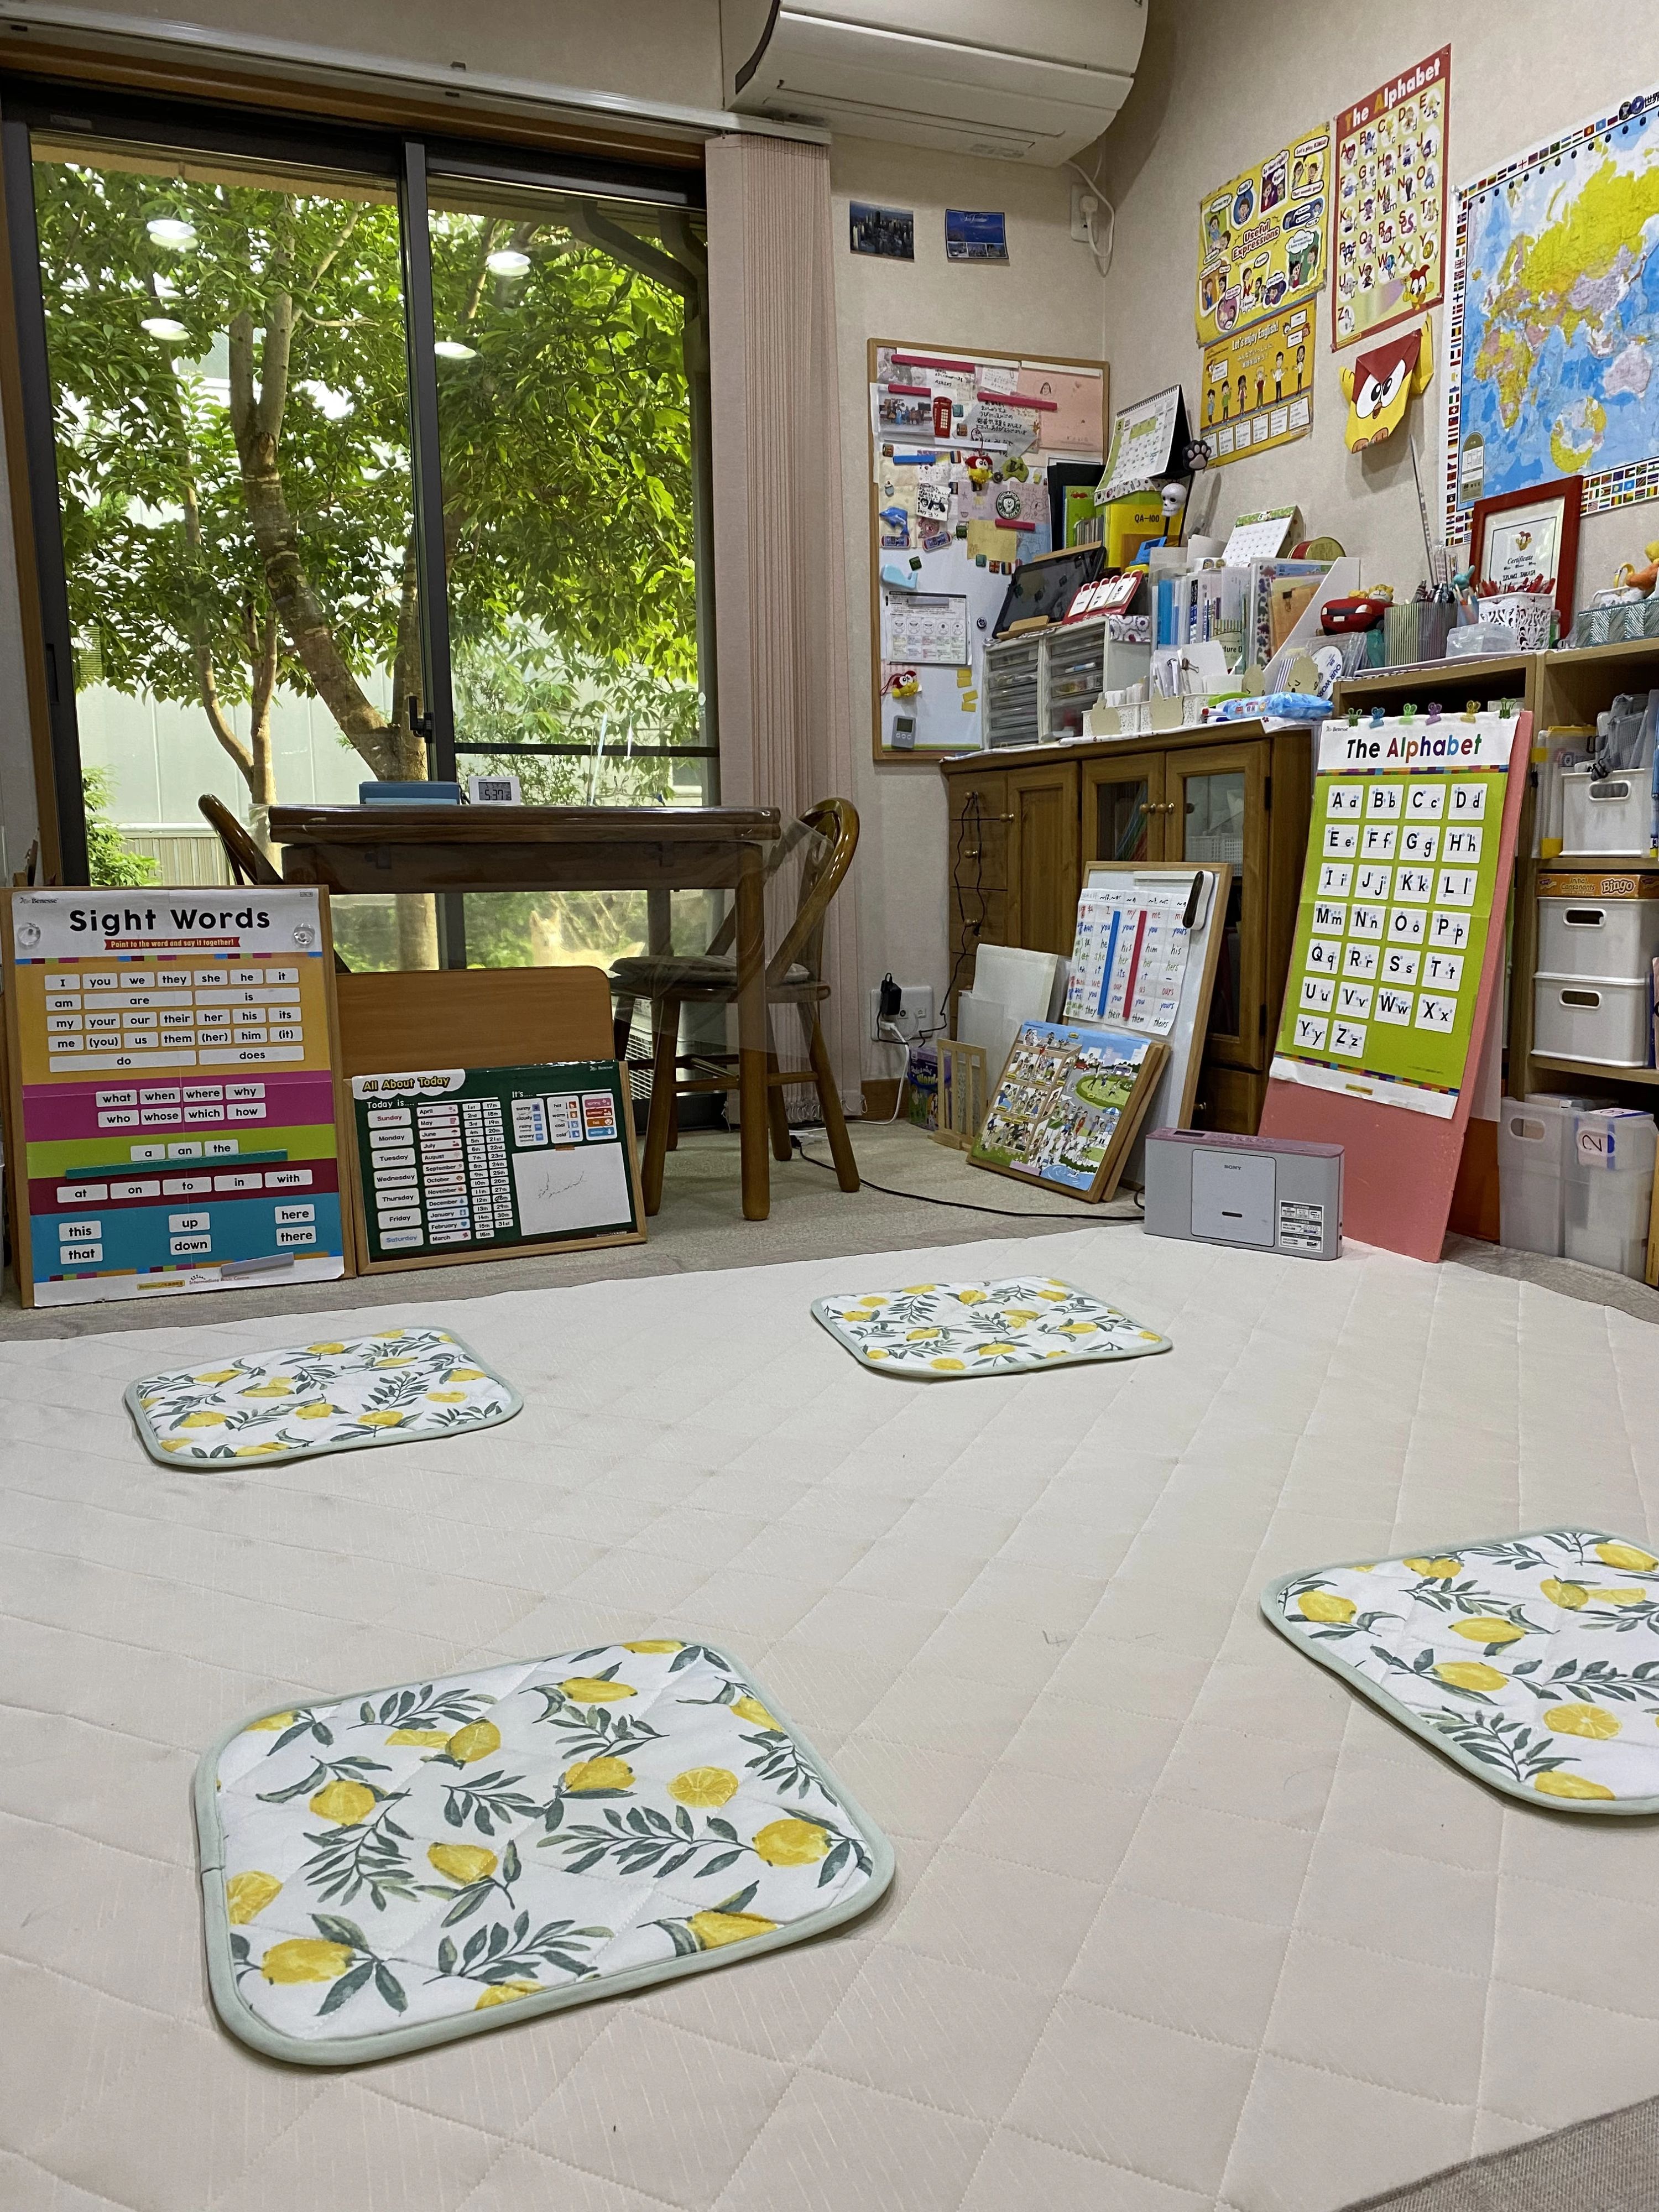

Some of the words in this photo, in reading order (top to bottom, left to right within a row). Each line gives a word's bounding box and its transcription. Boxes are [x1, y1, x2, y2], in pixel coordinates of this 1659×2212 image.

[1345, 106, 1369, 132] The
[1374, 58, 1440, 110] Alphabet
[1244, 221, 1270, 241] Useful
[1233, 229, 1279, 259] Expressions
[1232, 339, 1244, 351] Let's
[1244, 333, 1258, 346] enjoy
[1259, 321, 1279, 340] English!
[1117, 421, 1121, 430] 5
[1135, 514, 1159, 522] QA-100
[1507, 555, 1533, 564] Certificate
[1503, 573, 1517, 581] IZUMI
[1329, 664, 1341, 680] OUR
[1316, 680, 1332, 698] WOR
[1347, 739, 1380, 759] The
[1386, 734, 1481, 763] Alphabet
[485, 789, 503, 801] 5:37
[1602, 879, 1634, 894] Bingo
[1128, 910, 1135, 919] my
[70, 909, 156, 936] Sight
[170, 908, 269, 929] Words
[1100, 924, 1110, 933] you
[1122, 925, 1135, 933] your
[1148, 927, 1157, 936] you
[1172, 928, 1187, 937] yours
[111, 940, 127, 948] Point
[204, 938, 233, 946] together!
[1100, 940, 1107, 948] he
[1121, 943, 1131, 952] his
[1145, 943, 1157, 952] him
[1171, 944, 1181, 955] his
[1094, 952, 1105, 961] she
[1118, 955, 1128, 964] her
[1143, 959, 1152, 967] her
[1166, 961, 1178, 971] hers
[90, 979, 110, 988] you
[163, 976, 186, 985] they
[1088, 990, 1097, 1000] you
[1160, 1003, 1174, 1011] yours
[90, 1019, 116, 1028] your
[164, 1014, 190, 1023] their
[243, 1011, 257, 1020] his
[1085, 1004, 1097, 1017] they
[1108, 1009, 1120, 1019] their
[1132, 1014, 1144, 1022] them
[1154, 1019, 1168, 1028] theirs
[90, 1037, 118, 1048] (you)
[202, 1032, 227, 1042] (her)
[242, 1031, 260, 1040] him
[279, 1030, 293, 1039] (it)
[362, 1081, 378, 1092] All
[382, 1078, 414, 1090] About
[418, 1076, 450, 1088] Today
[102, 1093, 131, 1103] what
[145, 1092, 175, 1100] when
[234, 1088, 256, 1097] why
[367, 1100, 394, 1109] Today
[107, 1115, 130, 1123] who
[188, 1109, 220, 1118] which
[377, 1114, 403, 1122] Sunday
[379, 1134, 405, 1143] Monday
[1583, 1135, 1602, 1151] 2
[379, 1154, 409, 1162] Tuesday
[425, 1164, 456, 1172] September
[234, 1178, 244, 1186] in
[277, 1174, 300, 1183] with
[377, 1173, 415, 1183] Wednesday
[382, 1193, 414, 1203] Thursday
[281, 1211, 309, 1219] here
[389, 1214, 411, 1223] Friday
[69, 1226, 91, 1237] this
[182, 1220, 197, 1229] up
[431, 1222, 457, 1230] February
[281, 1233, 312, 1241] there
[386, 1235, 418, 1243] Saturday
[69, 1249, 95, 1260] that
[175, 1241, 207, 1250] down
